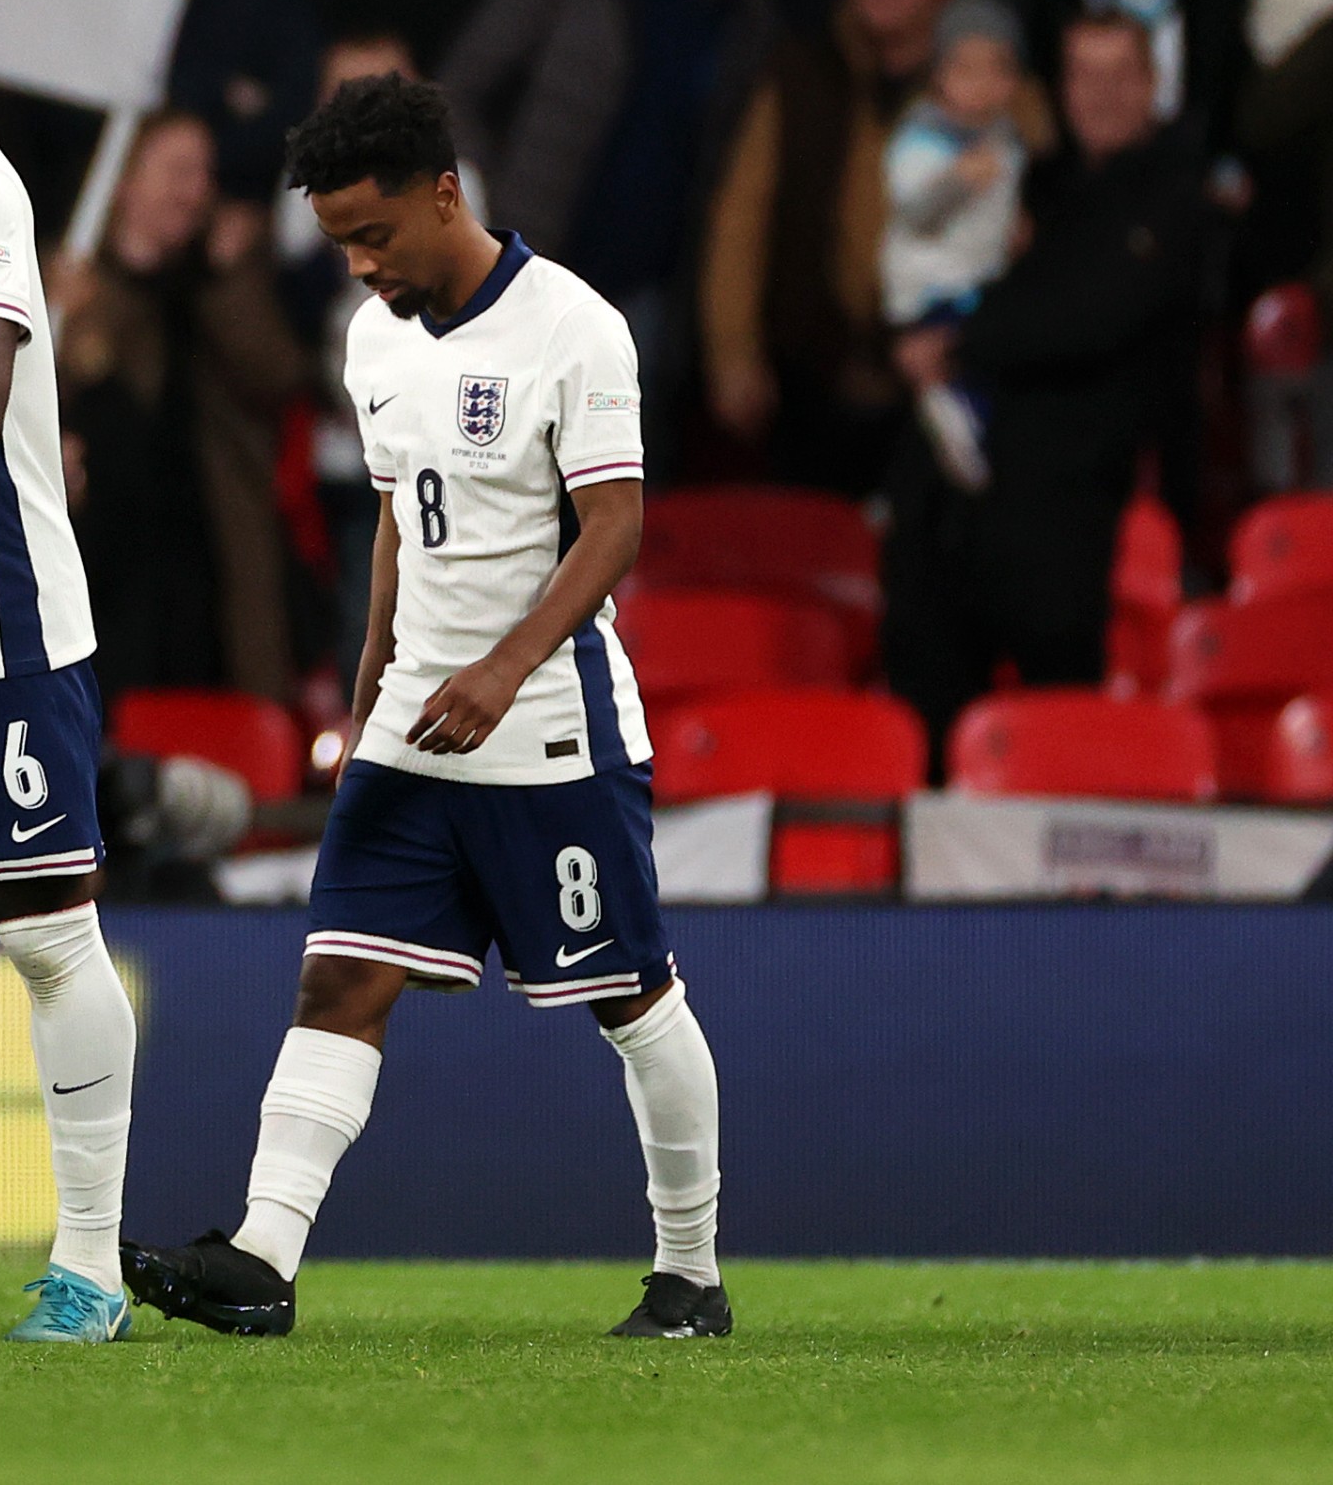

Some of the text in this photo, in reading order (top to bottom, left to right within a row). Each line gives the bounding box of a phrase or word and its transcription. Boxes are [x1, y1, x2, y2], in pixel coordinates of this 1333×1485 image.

[416, 467, 448, 549] 8
[3, 720, 49, 811] 6
[555, 845, 602, 932] 8
